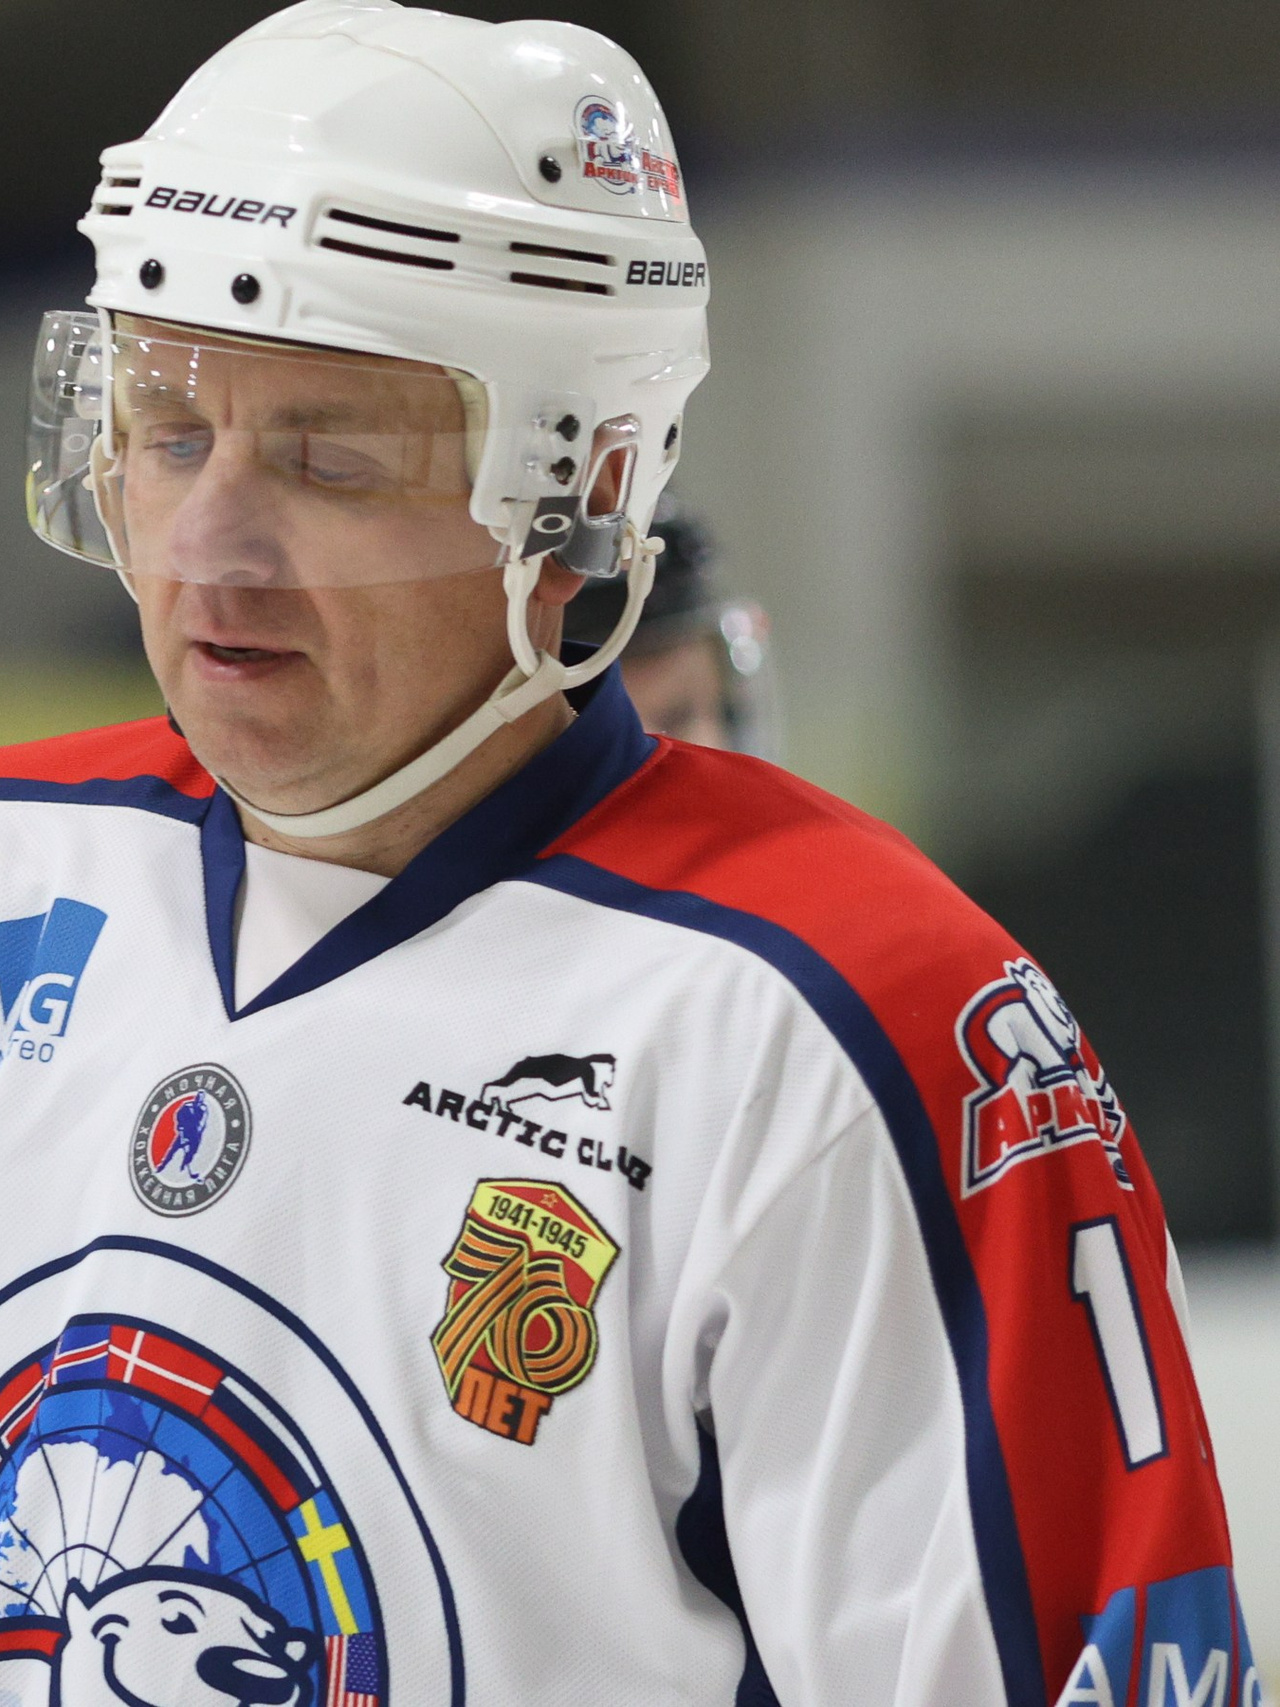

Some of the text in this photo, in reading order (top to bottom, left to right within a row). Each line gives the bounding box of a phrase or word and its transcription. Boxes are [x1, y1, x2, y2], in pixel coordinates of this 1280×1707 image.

[145, 187, 297, 228] BAUER
[626, 260, 706, 287] BAUER
[164, 1074, 237, 1110] НОЧНАЯ
[402, 1080, 567, 1159] ARCTIC
[135, 1126, 240, 1206] ХОККЕЙНАЯ ЛИГА
[488, 1194, 589, 1260] 1941-1945
